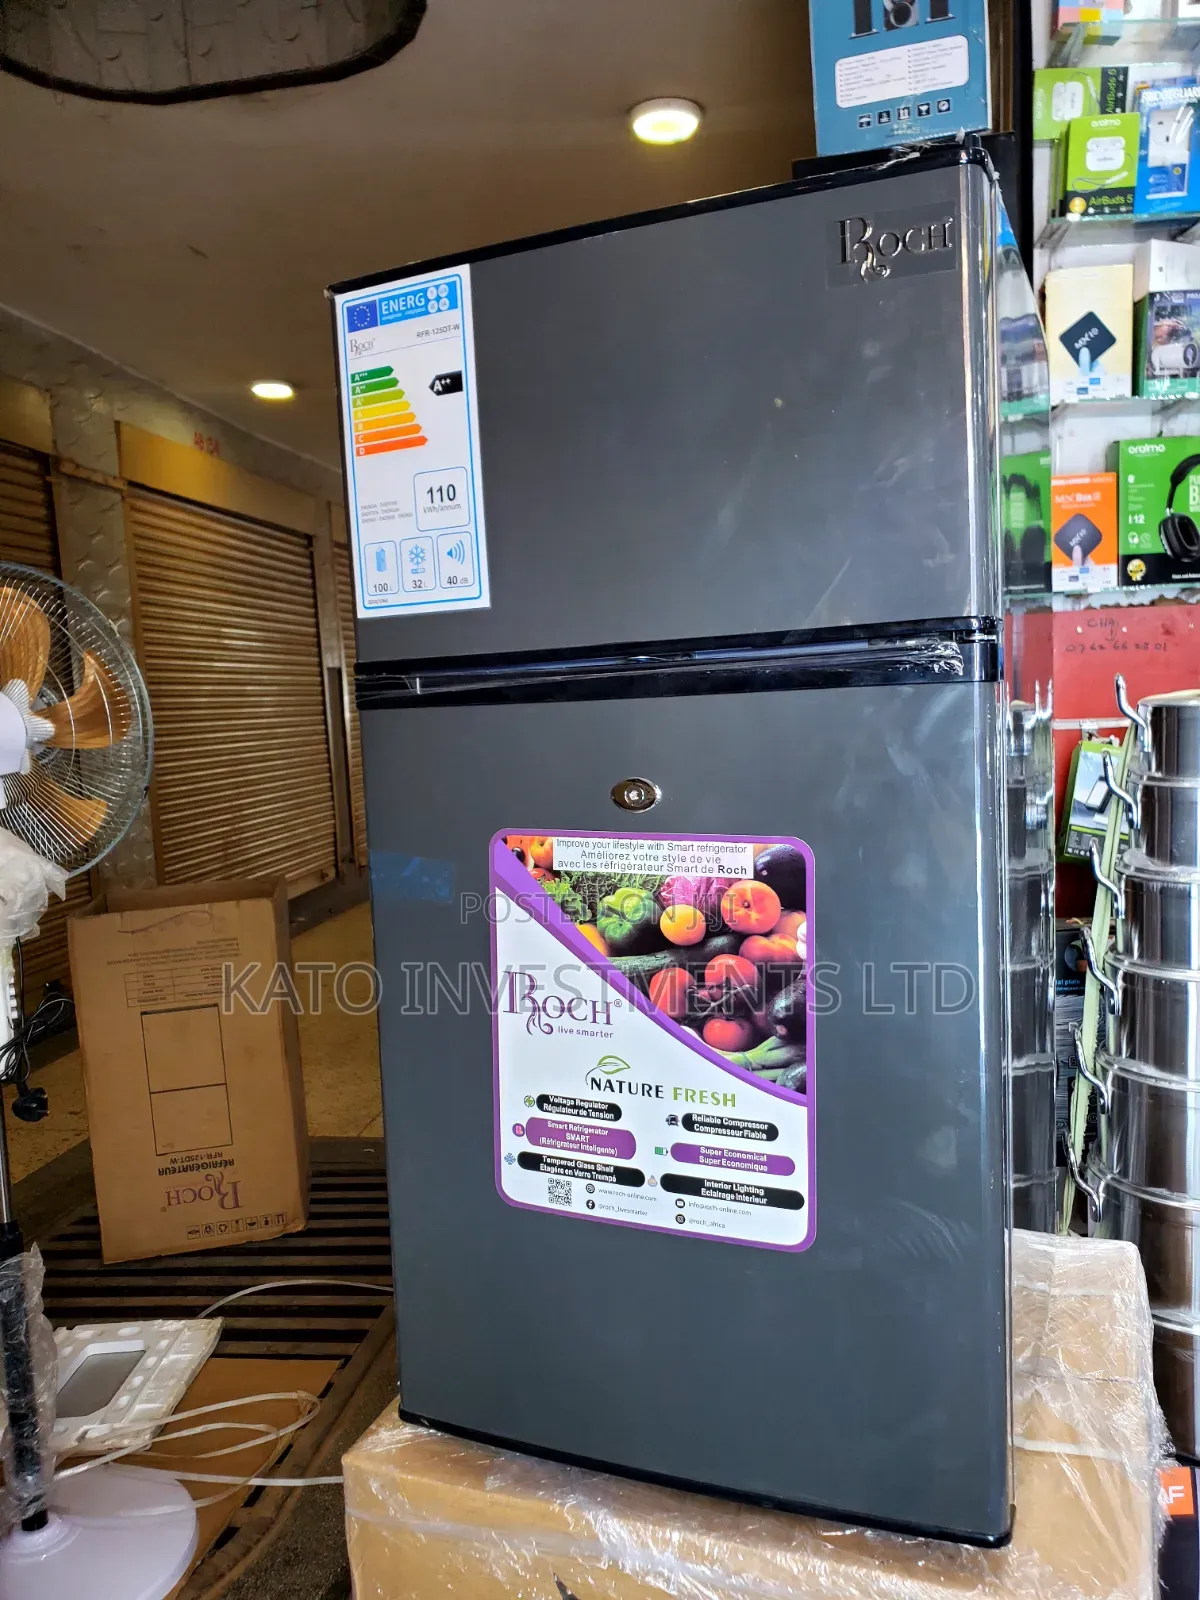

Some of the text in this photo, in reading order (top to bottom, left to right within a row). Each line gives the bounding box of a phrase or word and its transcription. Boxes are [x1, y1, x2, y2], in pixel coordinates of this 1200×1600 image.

[1088, 193, 1134, 206] AirBuds 5
[381, 292, 425, 315] ENERG
[416, 323, 460, 338] RFR-125DT-W
[433, 377, 451, 392] A++
[359, 447, 365, 455] D
[1128, 443, 1166, 455] oraimo
[426, 484, 457, 504] 110
[423, 503, 462, 514] kWh/annum
[412, 579, 423, 589] 32
[446, 575, 458, 585] 40
[373, 583, 389, 593] 100
[556, 838, 748, 855] Improve your lifestyle with Smart refrigerator
[580, 849, 722, 864] Améliorez votre style de vie
[557, 860, 747, 875] avec les réfrigérateur Smart de Roch
[557, 1025, 614, 1039] live smarter
[590, 1076, 736, 1108] NATURE FRESH
[548, 1094, 609, 1110] Voltage Regulator
[543, 1103, 578, 1116] Régulateur
[588, 1109, 615, 1120] Tension
[547, 1120, 609, 1136] Smart Refrigerator
[692, 1113, 769, 1130] Reliable Compressor
[565, 1132, 590, 1143] SMART
[694, 1123, 767, 1140] Compresseur Fiable
[169, 1151, 223, 1164] RFR-125DT-W
[700, 1146, 767, 1162] Super Economical
[542, 1155, 614, 1173] Tempered Glass Shelf
[699, 1155, 768, 1172] Super Economique
[564, 1168, 574, 1176] en
[701, 1187, 735, 1201] Eclairage
[704, 1179, 765, 1196] Interior Lighting
